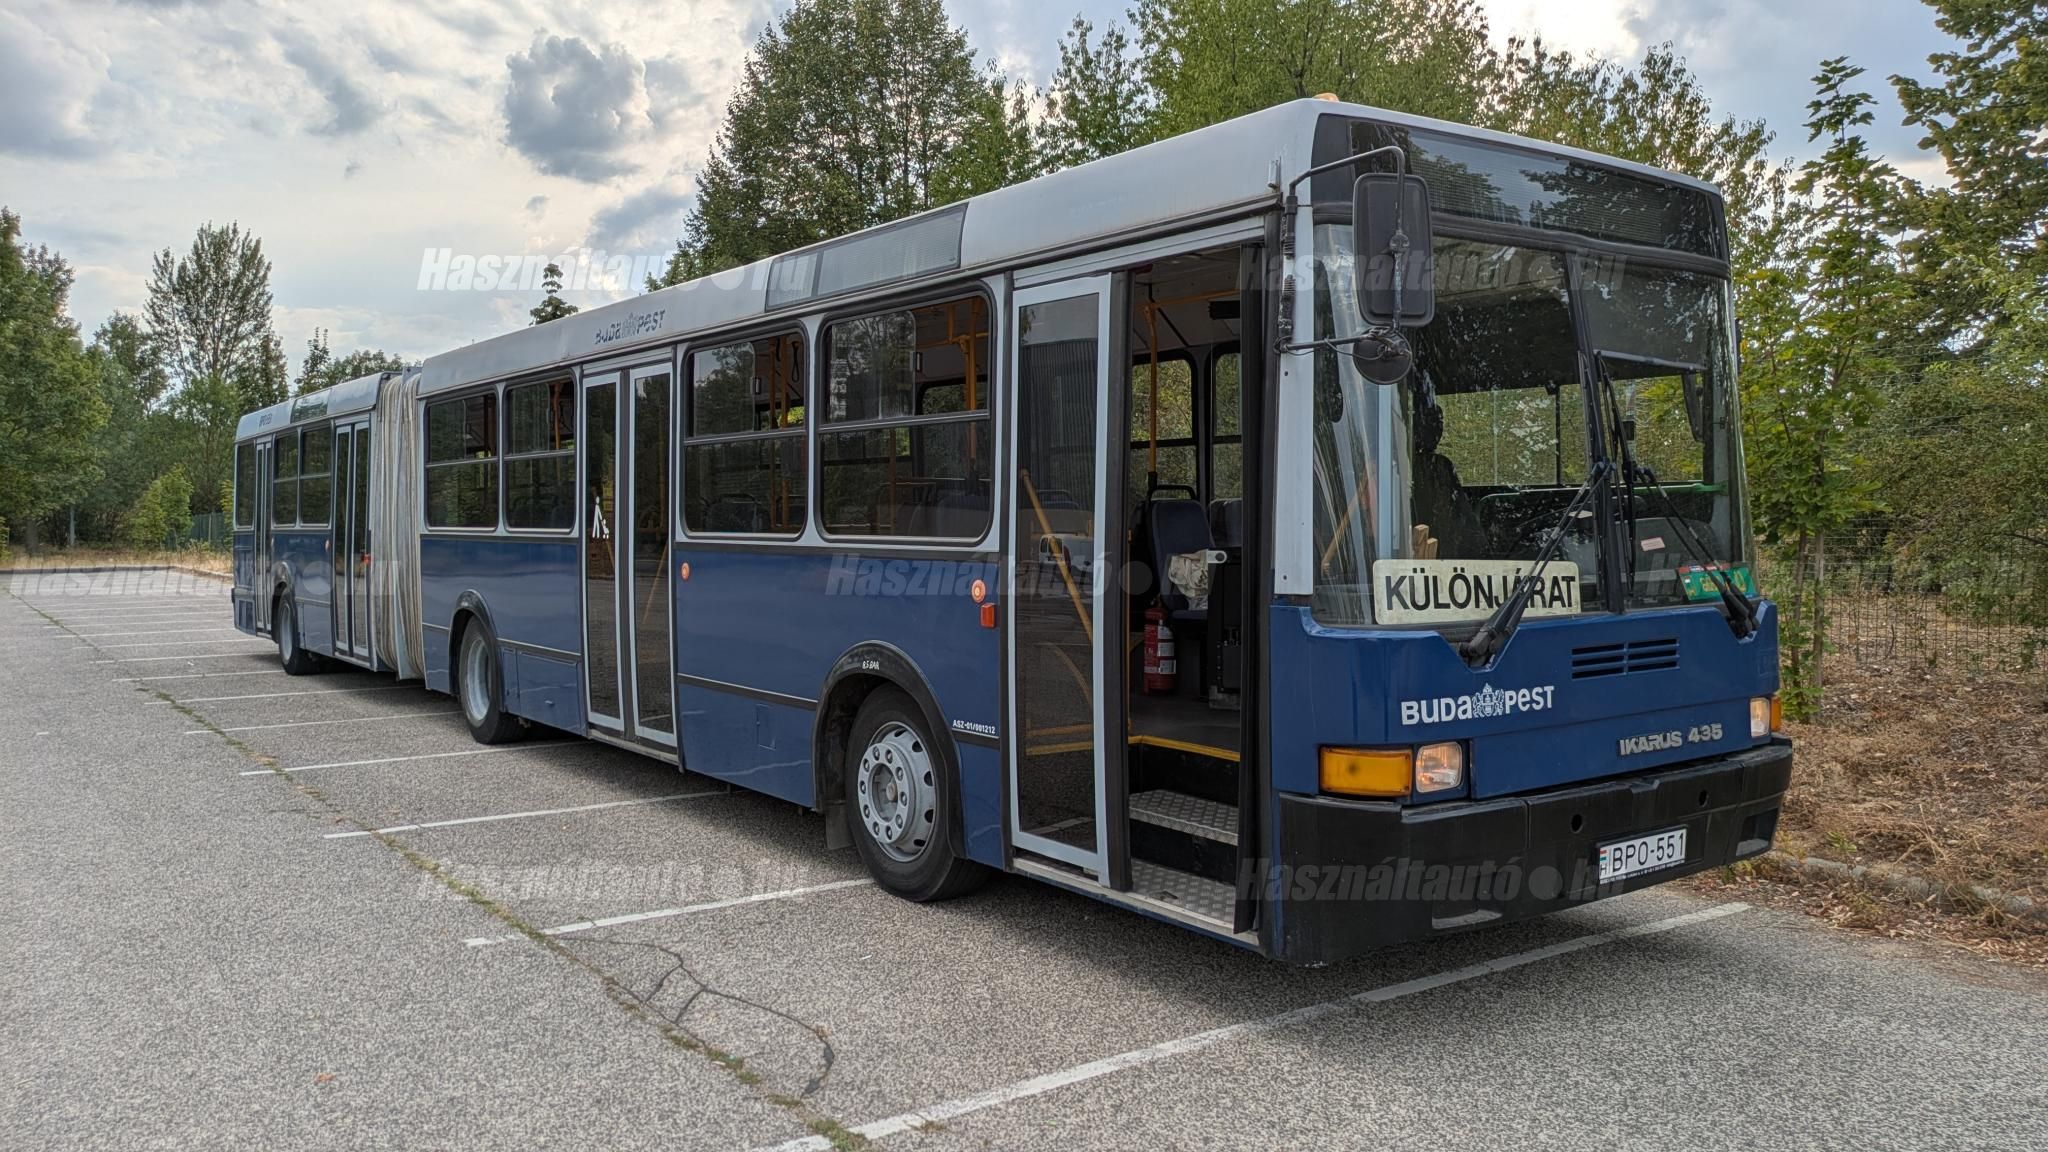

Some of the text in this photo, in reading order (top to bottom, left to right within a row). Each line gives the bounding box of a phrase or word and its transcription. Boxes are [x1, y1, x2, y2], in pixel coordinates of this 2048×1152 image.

[1618, 722, 1723, 756] IKARUS 435
[1612, 832, 1684, 873] BPO-551
